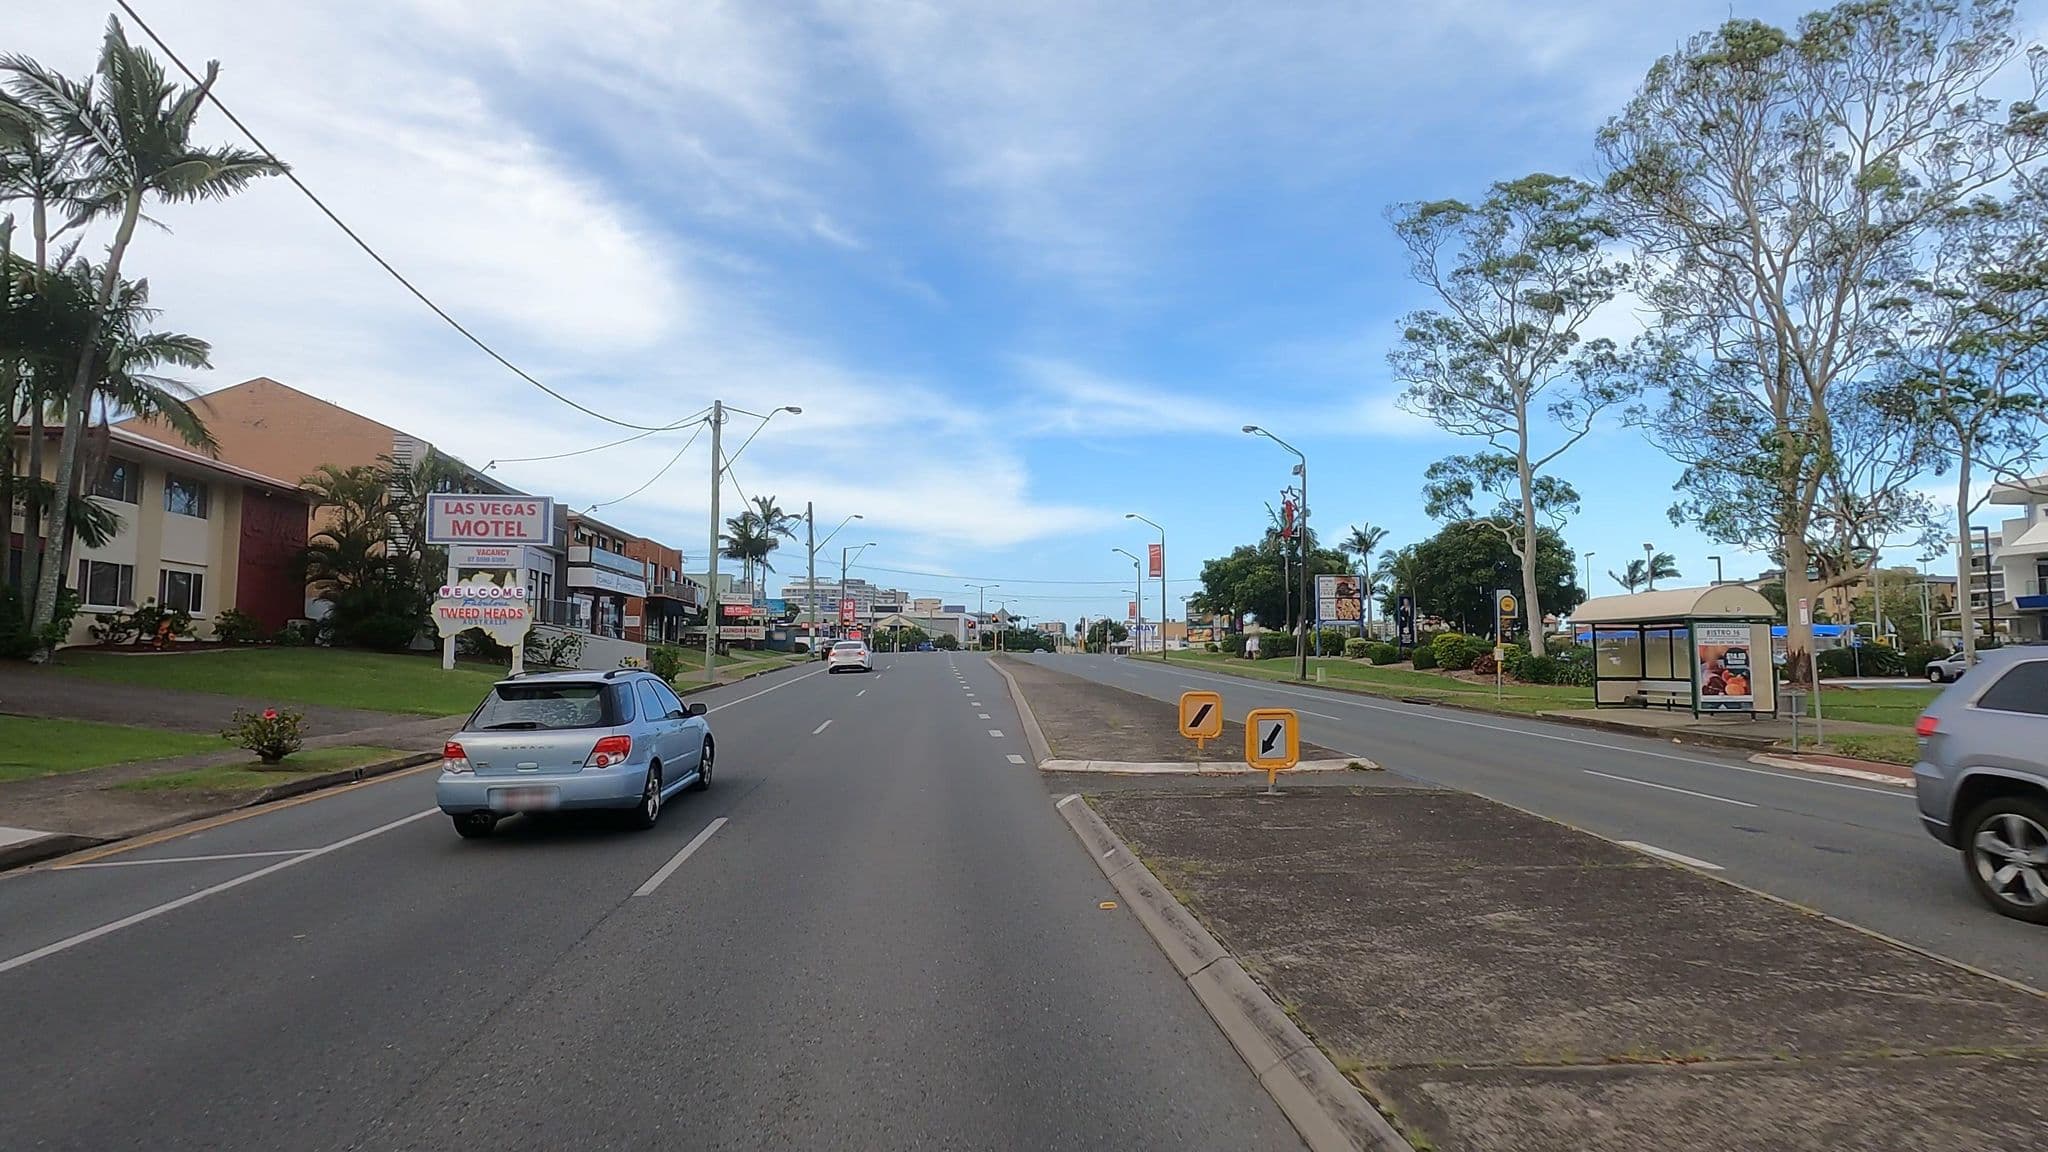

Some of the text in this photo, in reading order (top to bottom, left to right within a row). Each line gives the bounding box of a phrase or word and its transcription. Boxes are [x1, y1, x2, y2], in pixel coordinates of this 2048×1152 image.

[444, 502, 537, 516] LAS VEGAS
[451, 519, 528, 538] MOTEL
[476, 548, 510, 557] VACANCY
[441, 587, 524, 597] WELCOME
[439, 607, 524, 619] TWEED HEADS
